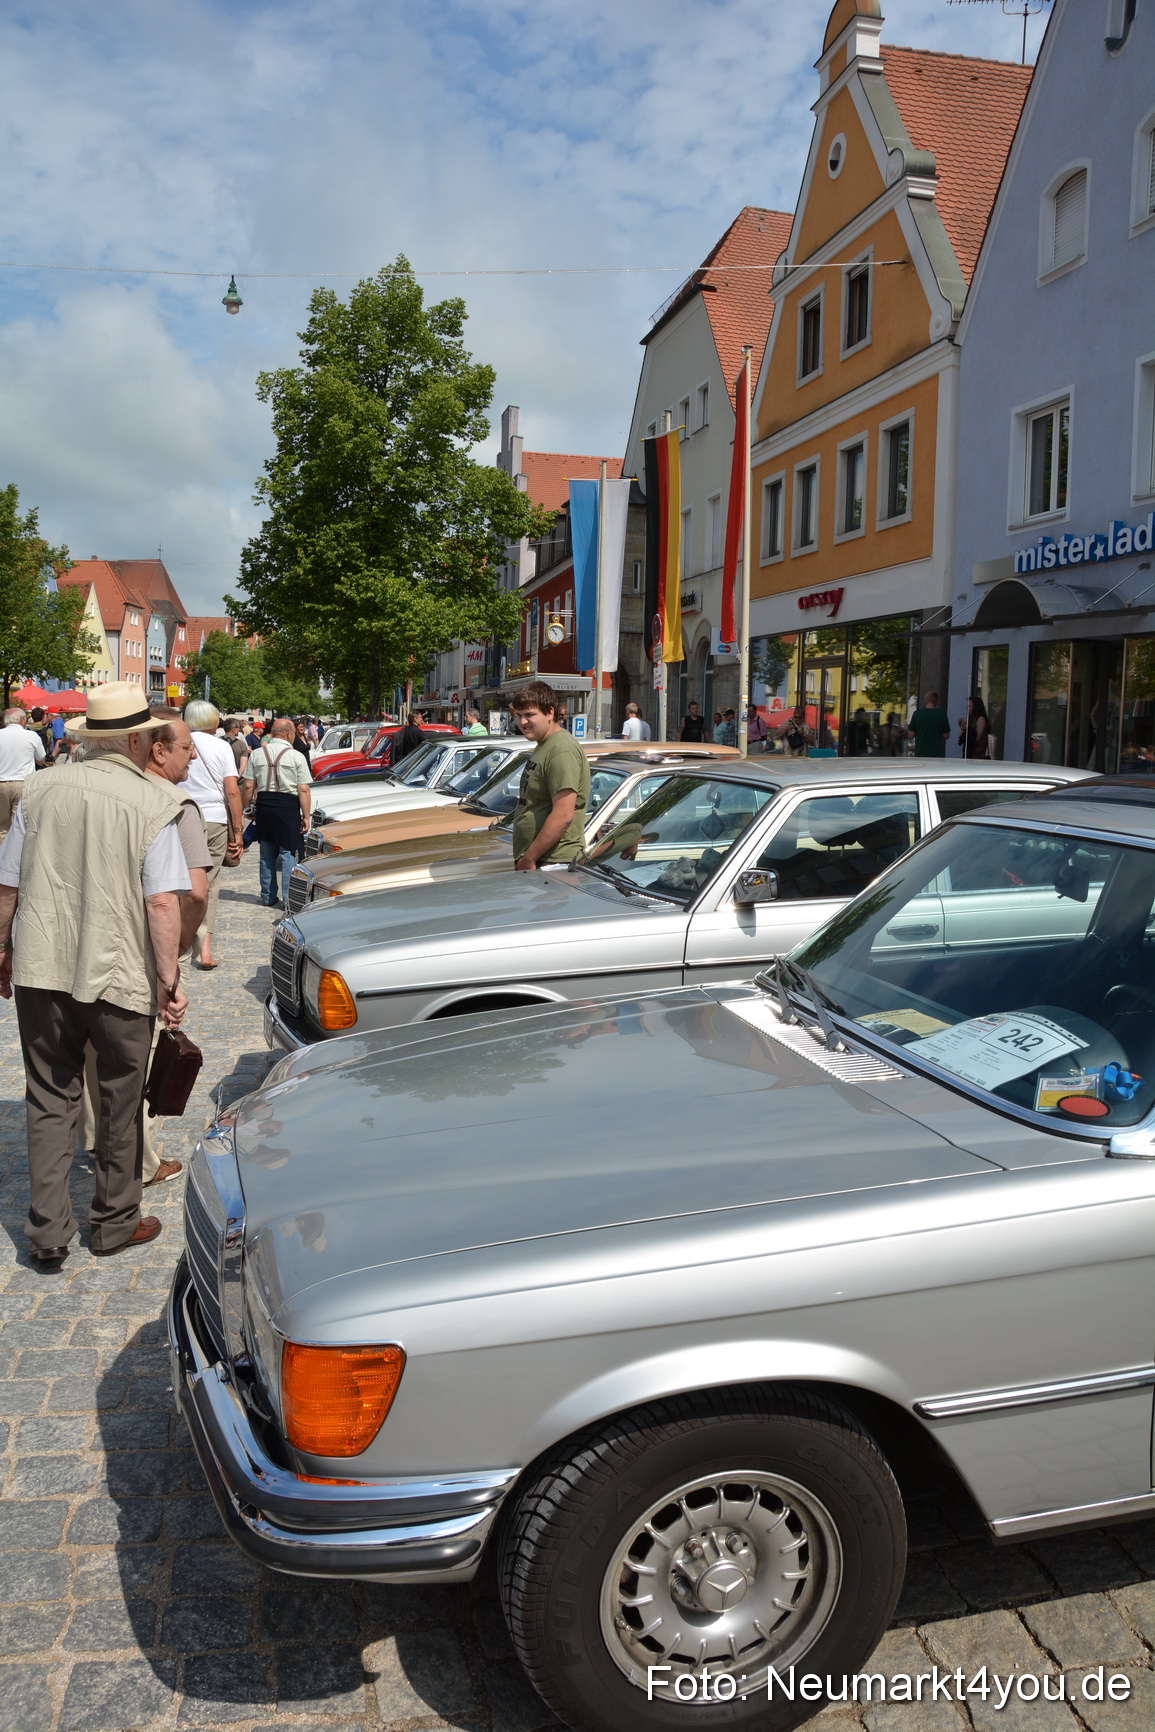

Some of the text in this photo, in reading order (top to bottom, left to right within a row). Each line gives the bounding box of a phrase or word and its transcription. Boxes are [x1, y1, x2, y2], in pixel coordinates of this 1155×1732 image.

[577, 720, 583, 730] P
[997, 1028, 1044, 1053] 242
[554, 1480, 644, 1667] FULDA
